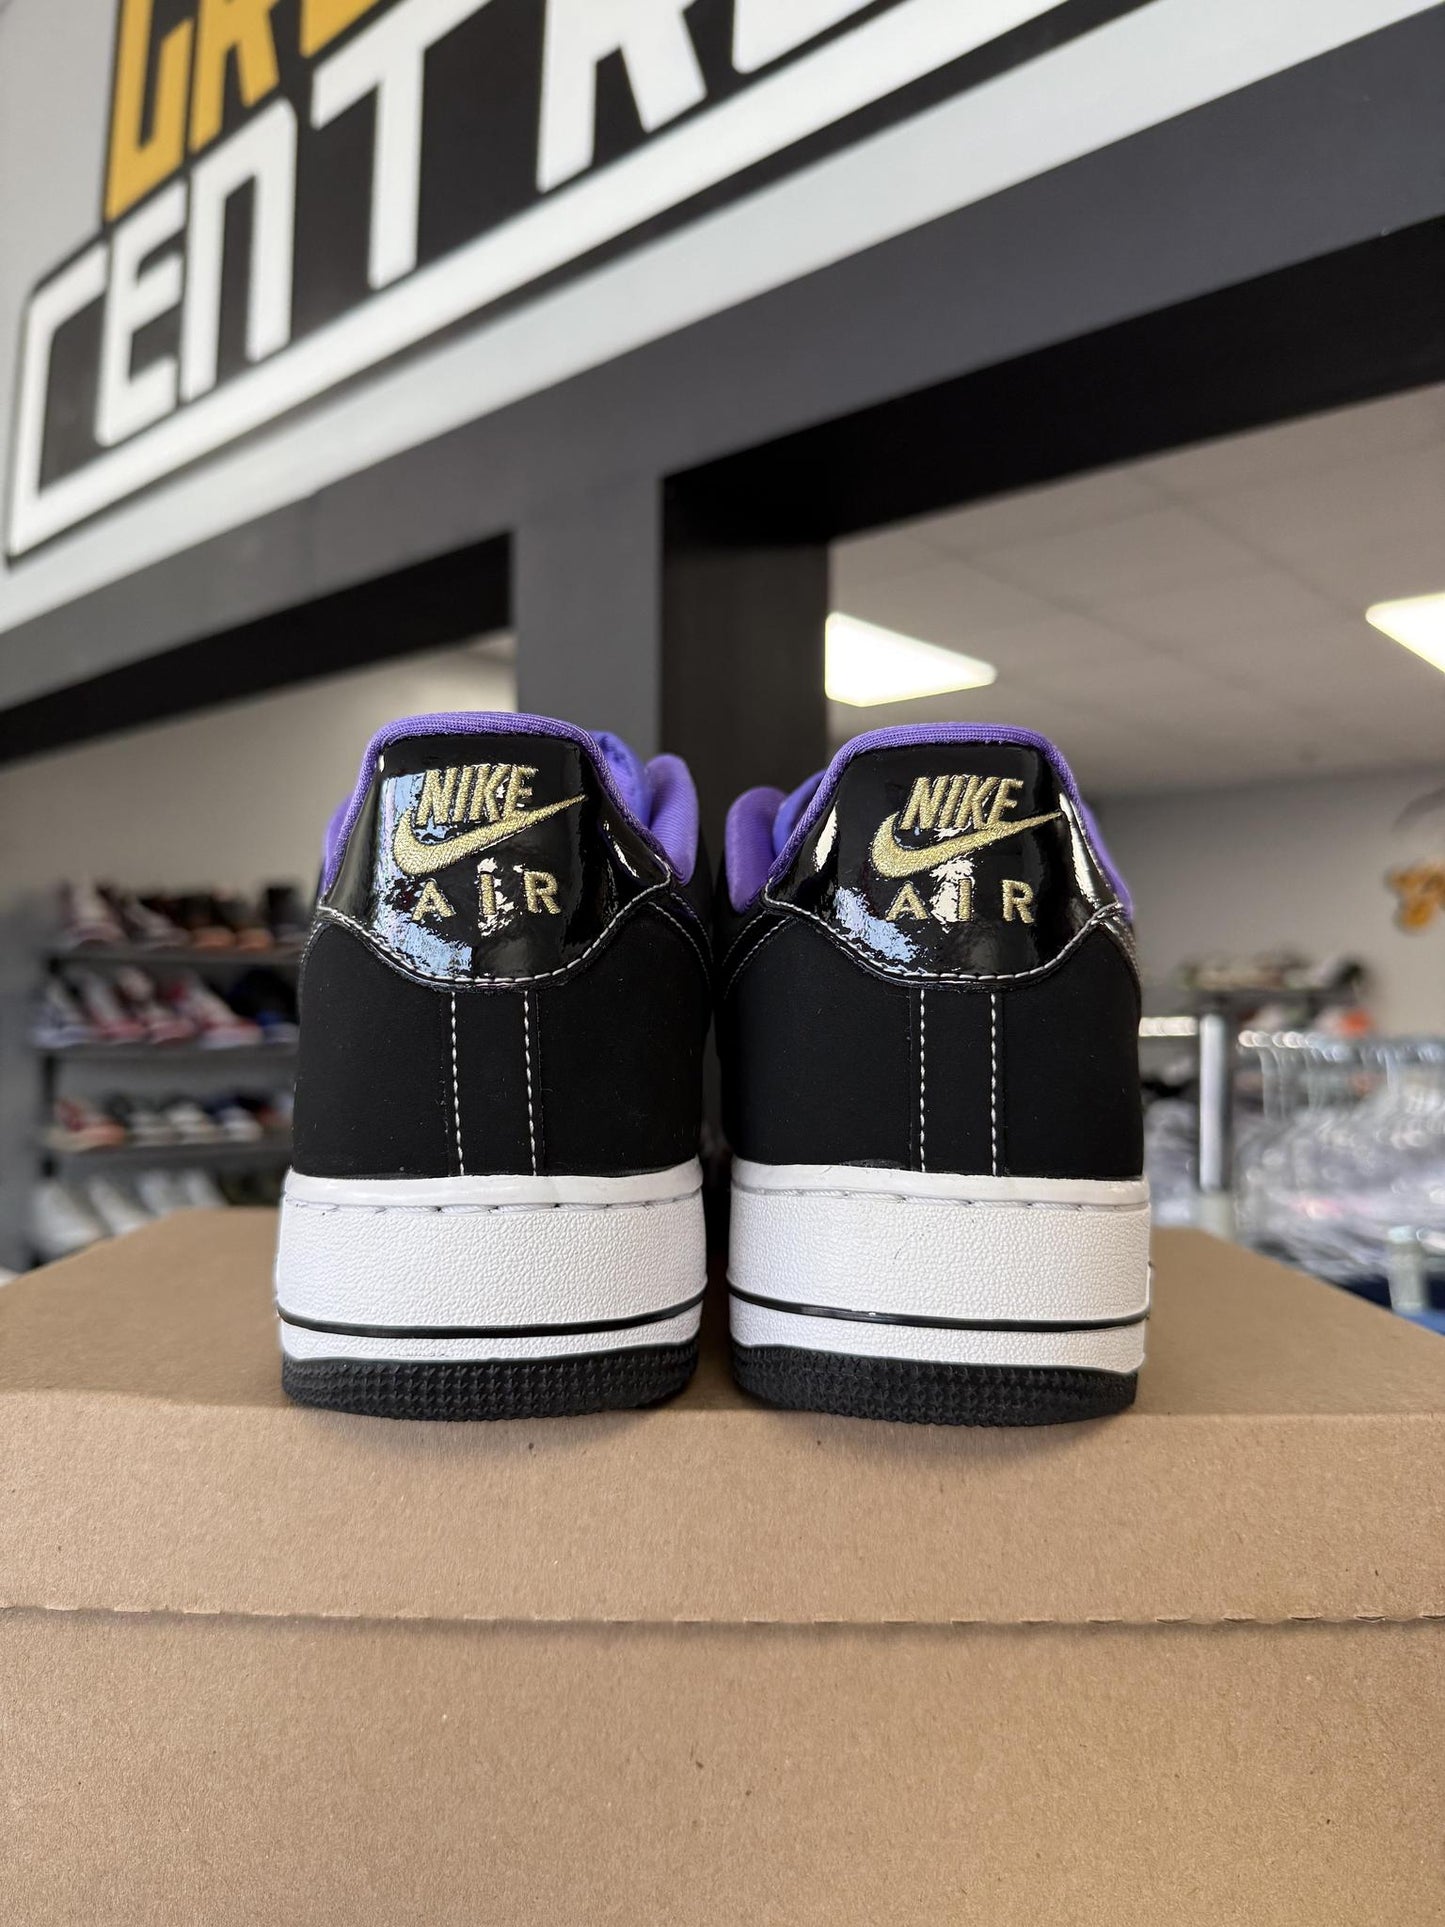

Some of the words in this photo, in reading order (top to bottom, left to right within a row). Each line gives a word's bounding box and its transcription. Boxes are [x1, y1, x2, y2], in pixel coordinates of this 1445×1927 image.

[414, 763, 539, 827] NIKE
[898, 774, 1025, 831] NIKE
[410, 869, 563, 922] AIR
[885, 878, 1035, 924] AIR
